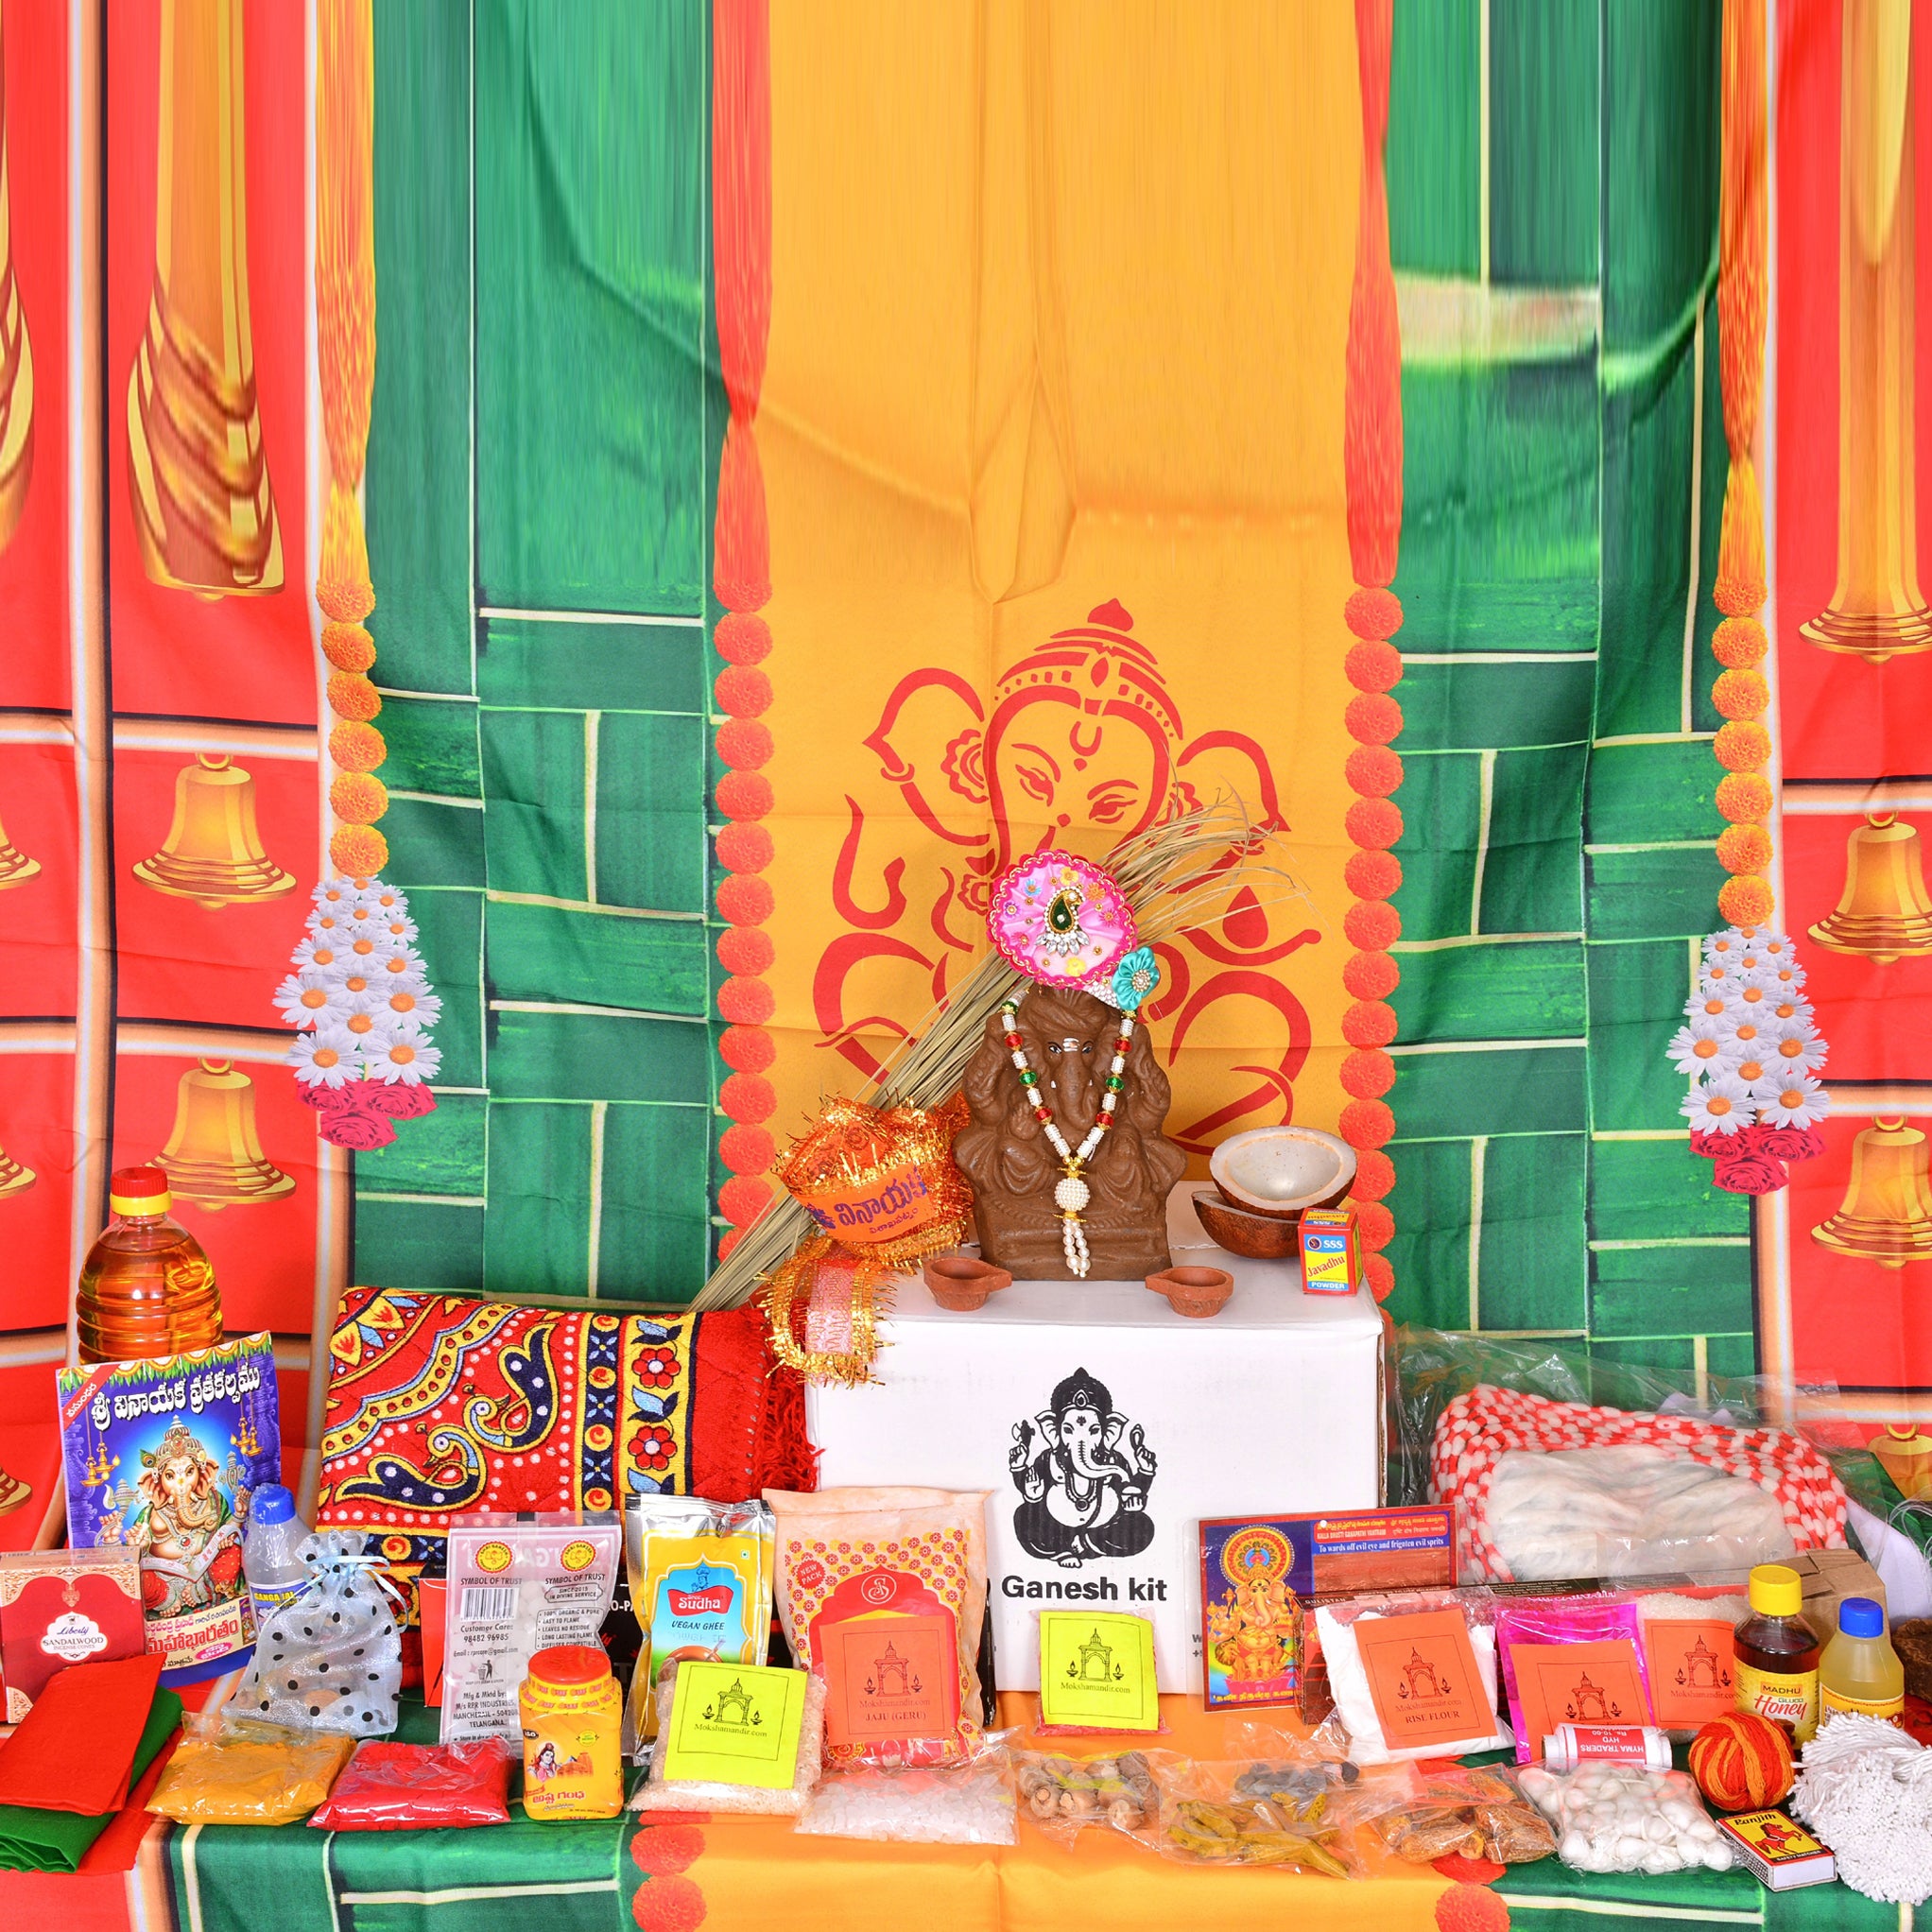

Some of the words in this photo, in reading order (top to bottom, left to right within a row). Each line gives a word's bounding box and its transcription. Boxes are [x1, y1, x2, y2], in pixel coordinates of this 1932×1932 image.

[1323, 1240, 1343, 1249] SSS
[1307, 1256, 1345, 1277] Javadhu
[91, 1391, 111, 1431] శ్రీ
[113, 1378, 186, 1421] వినాయక
[189, 1363, 261, 1414] వ్రతకల్పము
[1319, 1544, 1327, 1553] To
[1378, 1541, 1389, 1549] and
[1415, 1538, 1426, 1546] evil
[1427, 1537, 1444, 1546] sprits
[800, 1564, 818, 1576] NEW
[545, 1576, 571, 1585] SYMBOL
[802, 1571, 823, 1585] PACK
[1001, 1575, 1118, 1600] Ganesh
[1129, 1577, 1167, 1601] kit
[254, 1592, 280, 1602] GANGA
[678, 1596, 721, 1610] Sudha
[57, 1626, 89, 1635] Liberty
[671, 1620, 700, 1630] VEGAN
[702, 1622, 725, 1630] GHEE
[147, 1618, 239, 1653] మహాభారతం
[463, 1634, 485, 1643] 98482
[43, 1637, 104, 1647] SANDALWOOD
[1061, 1682, 1130, 1694] Mokshamandir.com
[1762, 1684, 1801, 1694] MADHU
[1670, 1690, 1734, 1700] Mokshamandir.co
[859, 1699, 930, 1708] Mokshamandir.com
[1395, 1699, 1462, 1713] Mokshamandir.com
[1754, 1695, 1807, 1720] Honey
[866, 1713, 887, 1721] JAJU
[891, 1712, 926, 1720] (GERU)
[1406, 1714, 1427, 1724] RISE
[1429, 1711, 1460, 1720] FLOUR
[694, 1723, 767, 1737] Mokshamandir.com
[558, 1790, 585, 1800] గంధ
[1734, 1813, 1777, 1826] Ranjith
